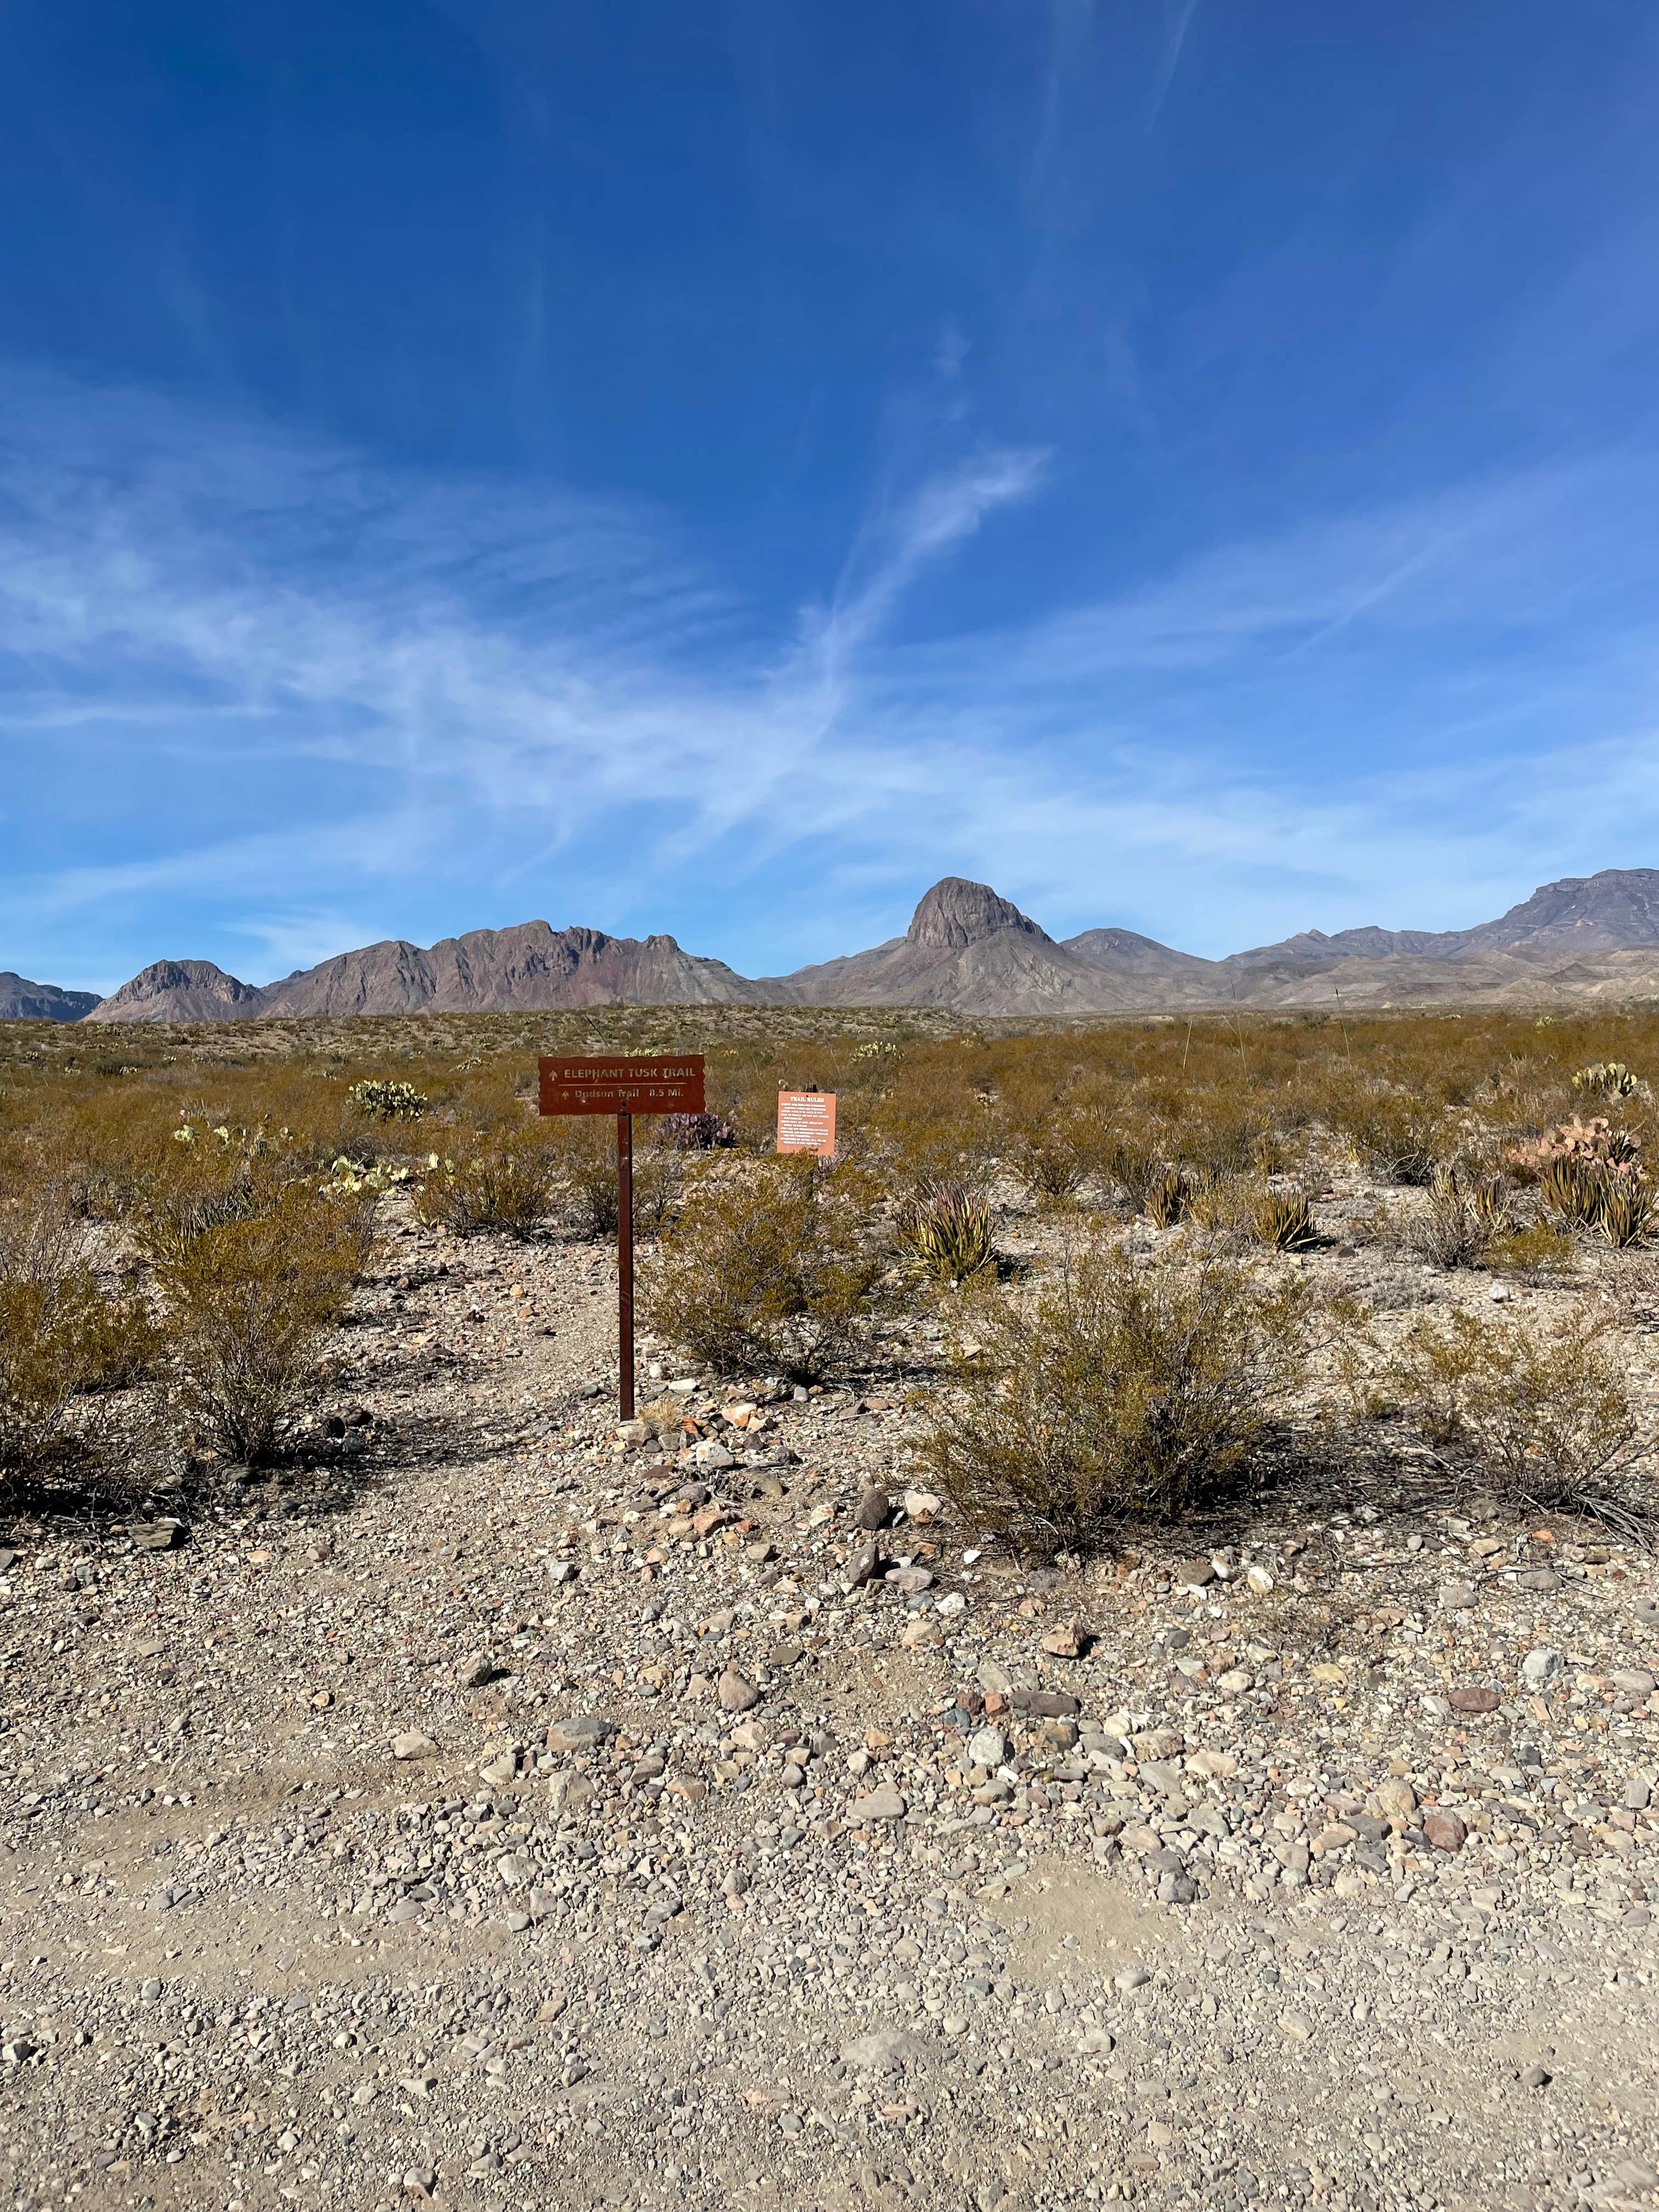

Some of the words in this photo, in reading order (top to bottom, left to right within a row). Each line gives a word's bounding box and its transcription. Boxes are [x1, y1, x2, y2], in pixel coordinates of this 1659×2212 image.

[565, 1068, 623, 1079] ELEPHANT
[629, 1068, 658, 1077] TUSK
[662, 1068, 696, 1077] TRAIL
[575, 1089, 613, 1098] Dodson
[617, 1089, 639, 1097] Trail
[649, 1088, 664, 1097] 8.5
[668, 1088, 684, 1097] Mi.
